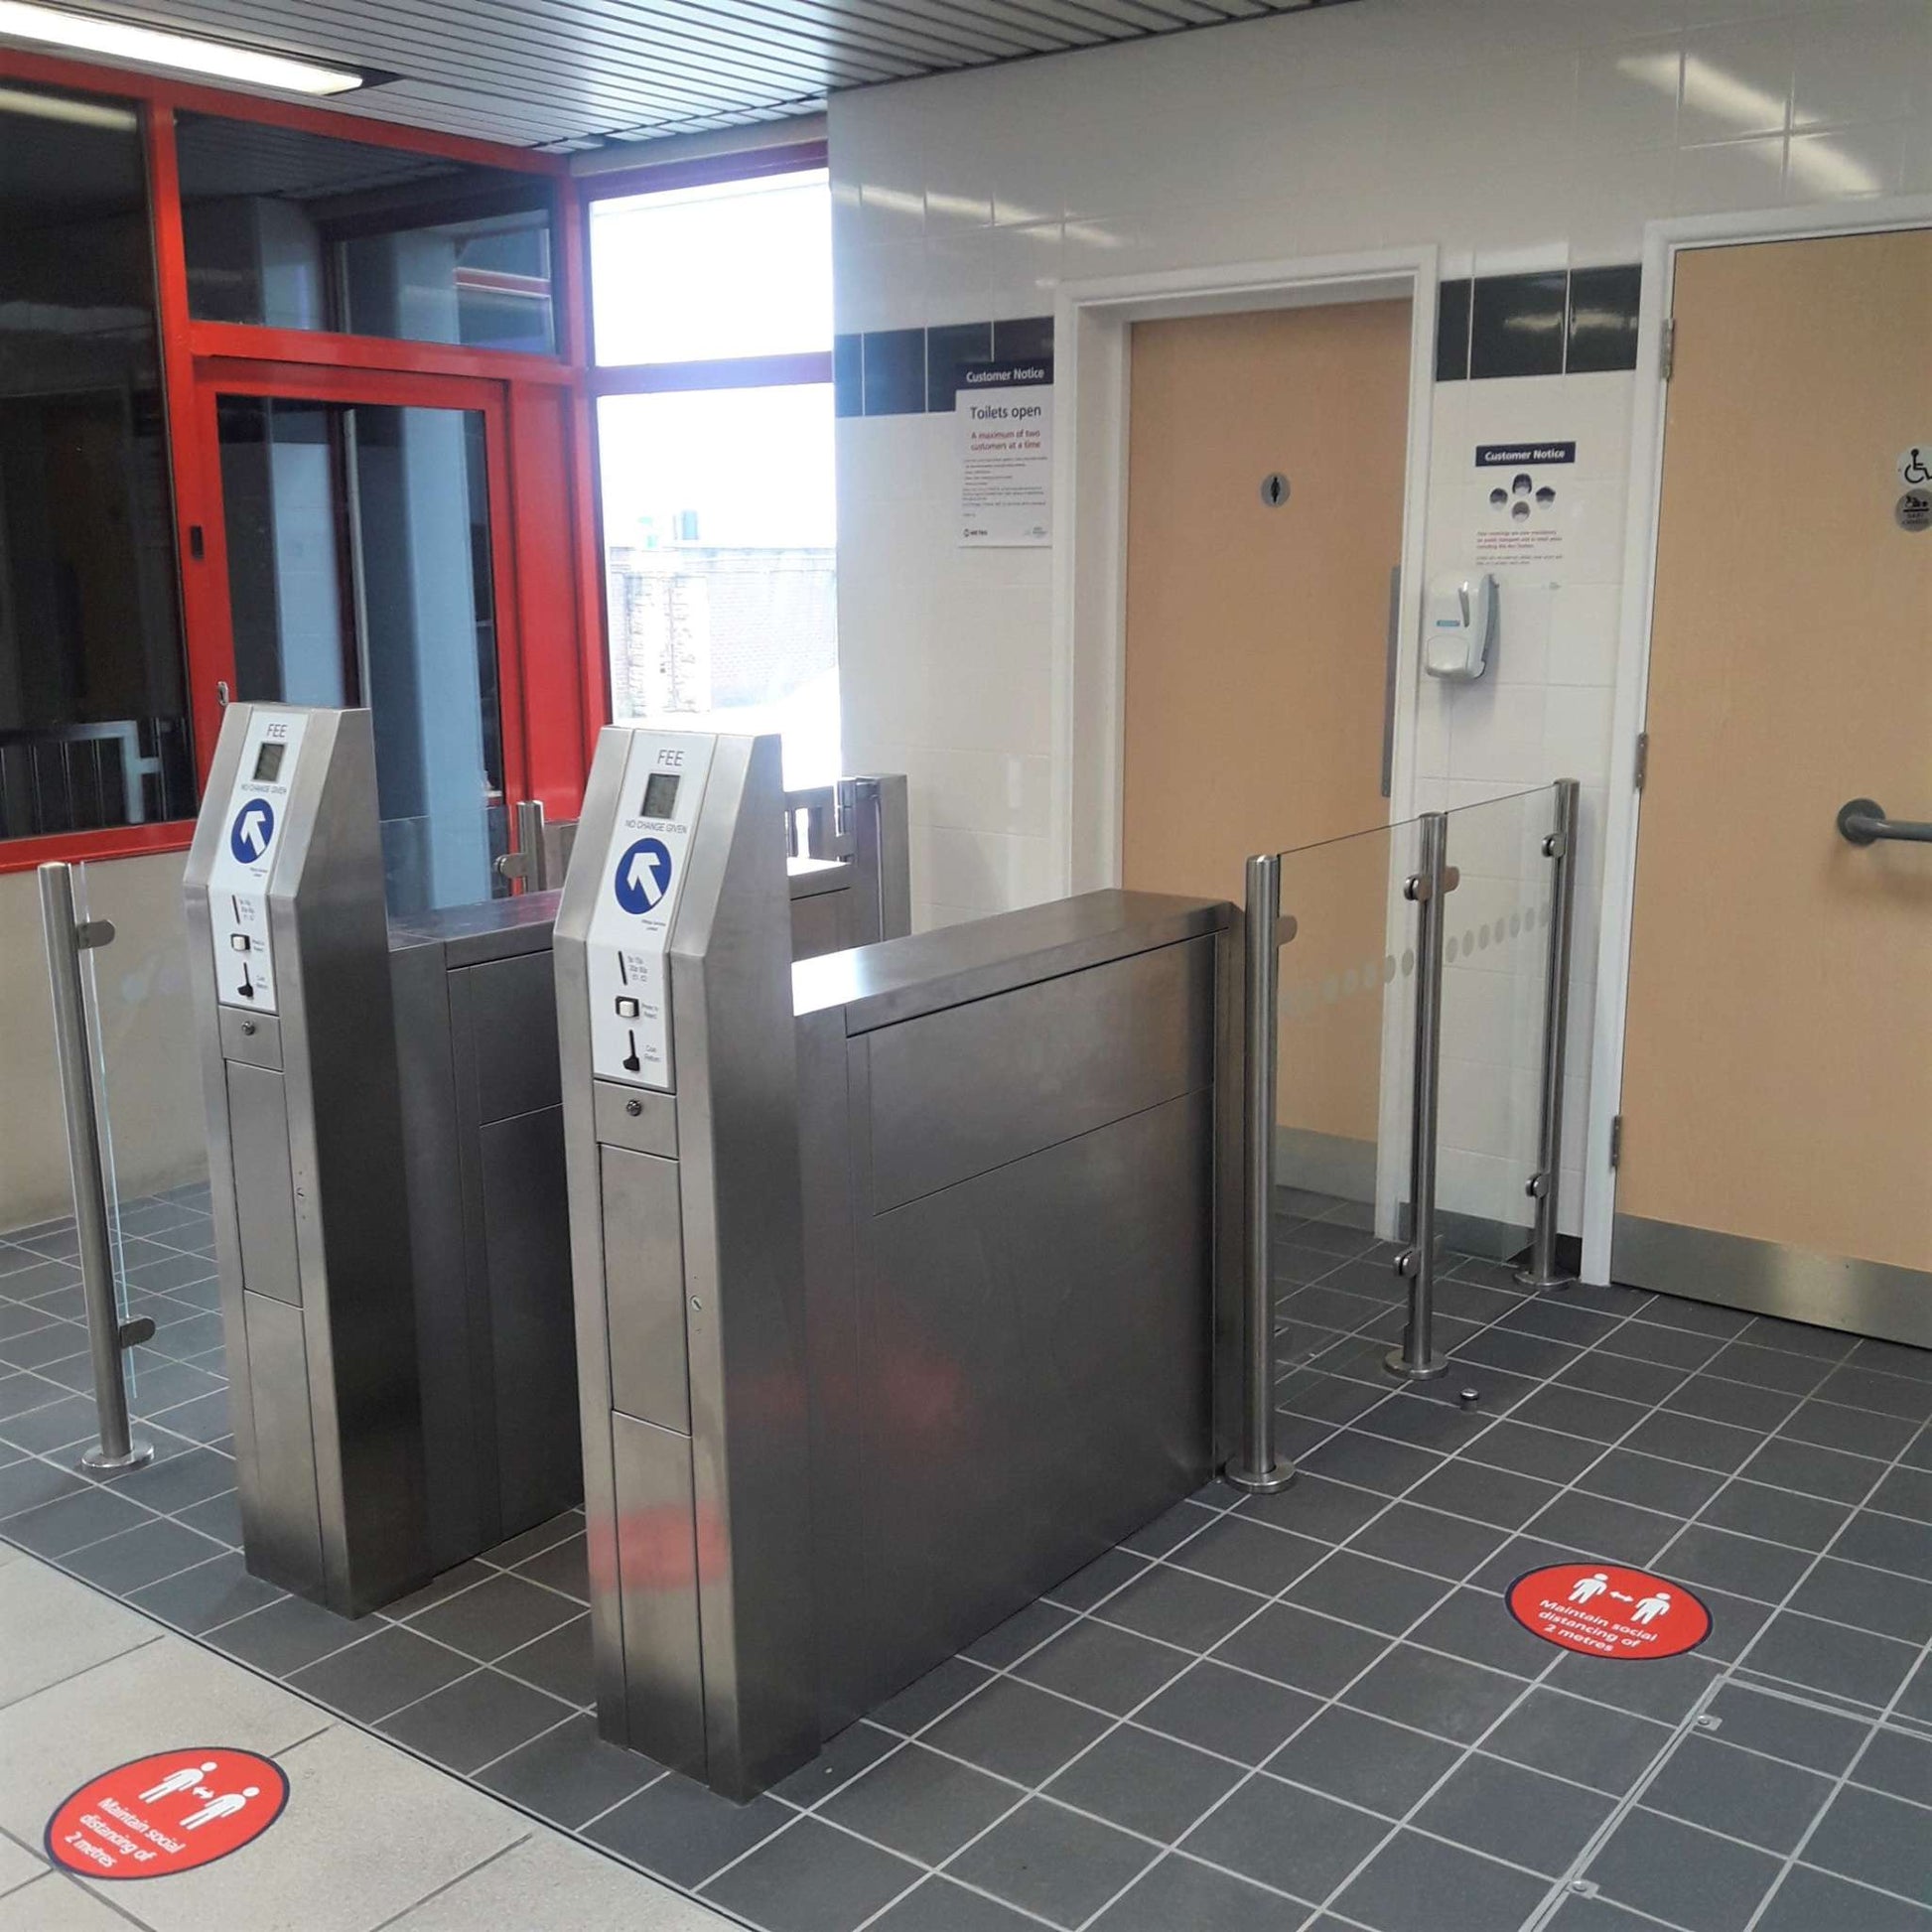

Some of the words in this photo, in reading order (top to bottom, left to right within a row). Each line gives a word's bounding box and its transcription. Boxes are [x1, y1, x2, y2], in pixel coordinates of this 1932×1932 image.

[966, 370, 1012, 383] Customer
[1014, 366, 1045, 380] Notice
[970, 405, 1009, 420] Toilets
[1011, 406, 1041, 421] open
[1484, 451, 1532, 462] Customer
[1533, 448, 1567, 460] Notice
[266, 723, 288, 739] FEE
[657, 749, 685, 766] FEE
[624, 819, 635, 829] NO
[636, 820, 665, 832] CHANGE
[666, 822, 687, 834] GIVEN
[1538, 1599, 1609, 1628] Maintain
[1611, 1622, 1660, 1643] social
[1538, 1610, 1619, 1643] distancing
[1620, 1637, 1642, 1648] of
[1543, 1624, 1557, 1633] 2
[1558, 1629, 1614, 1653] metres
[97, 1797, 150, 1834] Maintain
[146, 1828, 186, 1855] social
[64, 1831, 78, 1844] 2
[74, 1840, 118, 1868] metres
[79, 1814, 134, 1855] distancing
[134, 1848, 158, 1863] of
